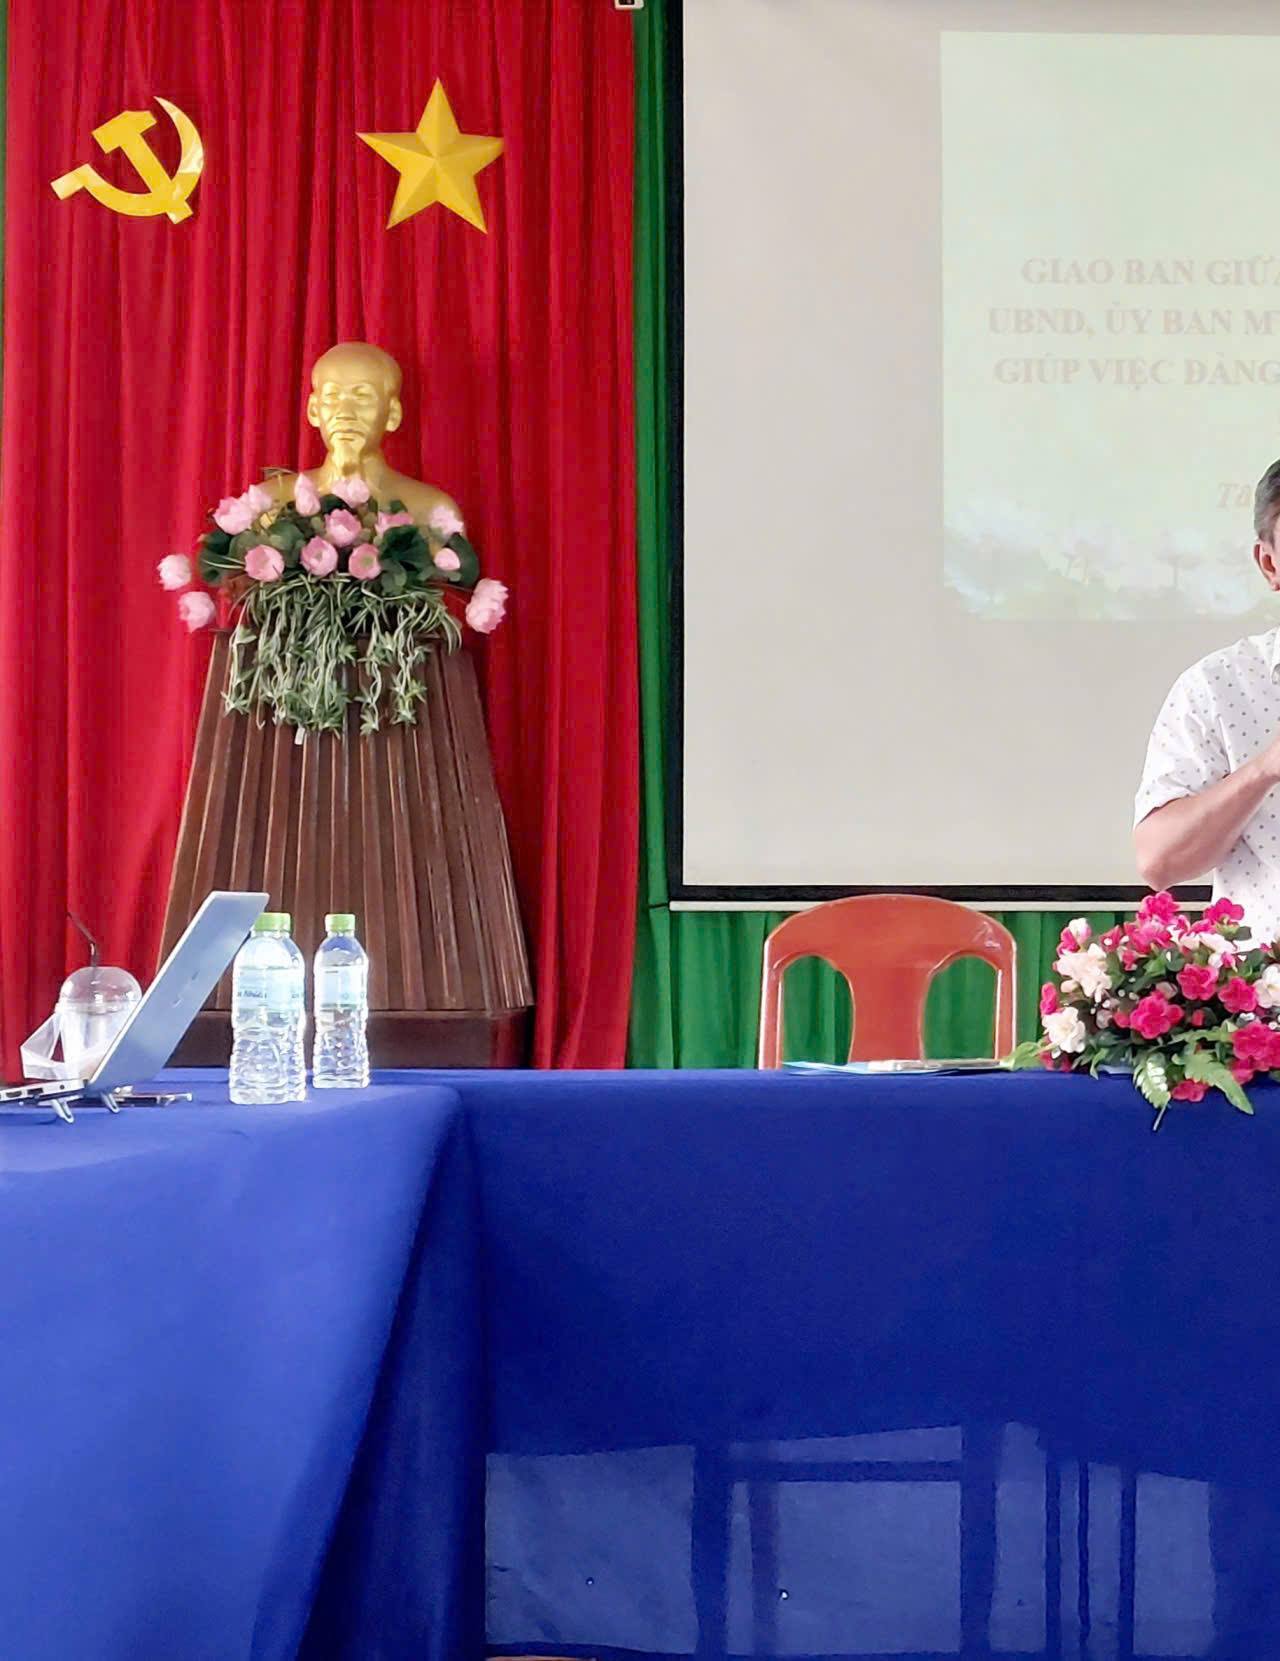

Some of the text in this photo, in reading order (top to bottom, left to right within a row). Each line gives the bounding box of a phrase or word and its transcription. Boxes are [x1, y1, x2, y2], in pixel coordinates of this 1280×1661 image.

[1020, 258, 1114, 287] GIAO
[1123, 259, 1195, 285] BAN
[987, 308, 1096, 339] UBND,
[1105, 302, 1153, 335] ỦY
[1162, 309, 1232, 335] BAN
[992, 352, 1081, 386] GIÚP
[1088, 356, 1178, 392] VIỆC
[1216, 479, 1254, 509] Tâ
